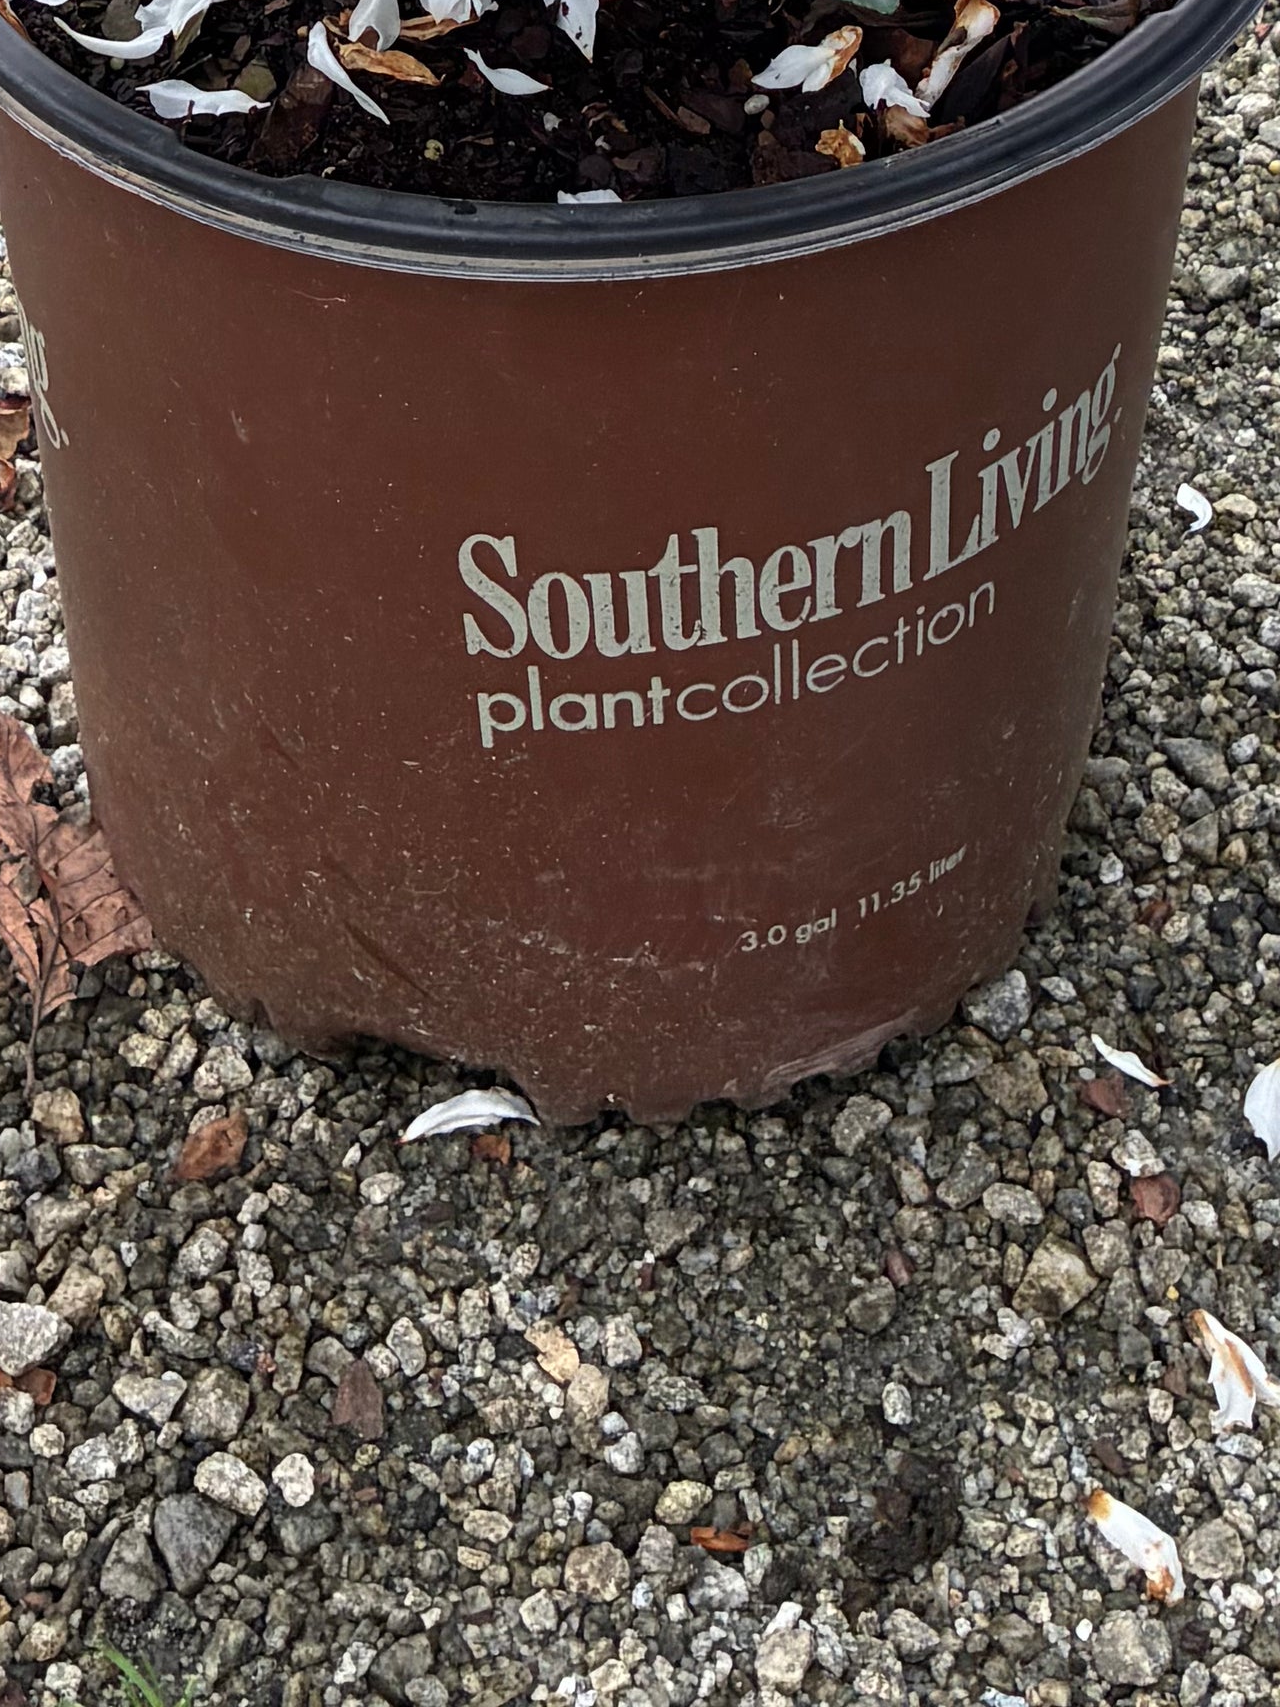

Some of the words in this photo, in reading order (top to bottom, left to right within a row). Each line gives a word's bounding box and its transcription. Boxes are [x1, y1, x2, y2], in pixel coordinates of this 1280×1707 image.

[458, 510, 913, 660] Southern
[923, 343, 1121, 581] Living
[741, 925, 786, 951] 3.0
[795, 908, 837, 943] gal
[858, 870, 921, 918] 11.35
[929, 844, 967, 884] liter
